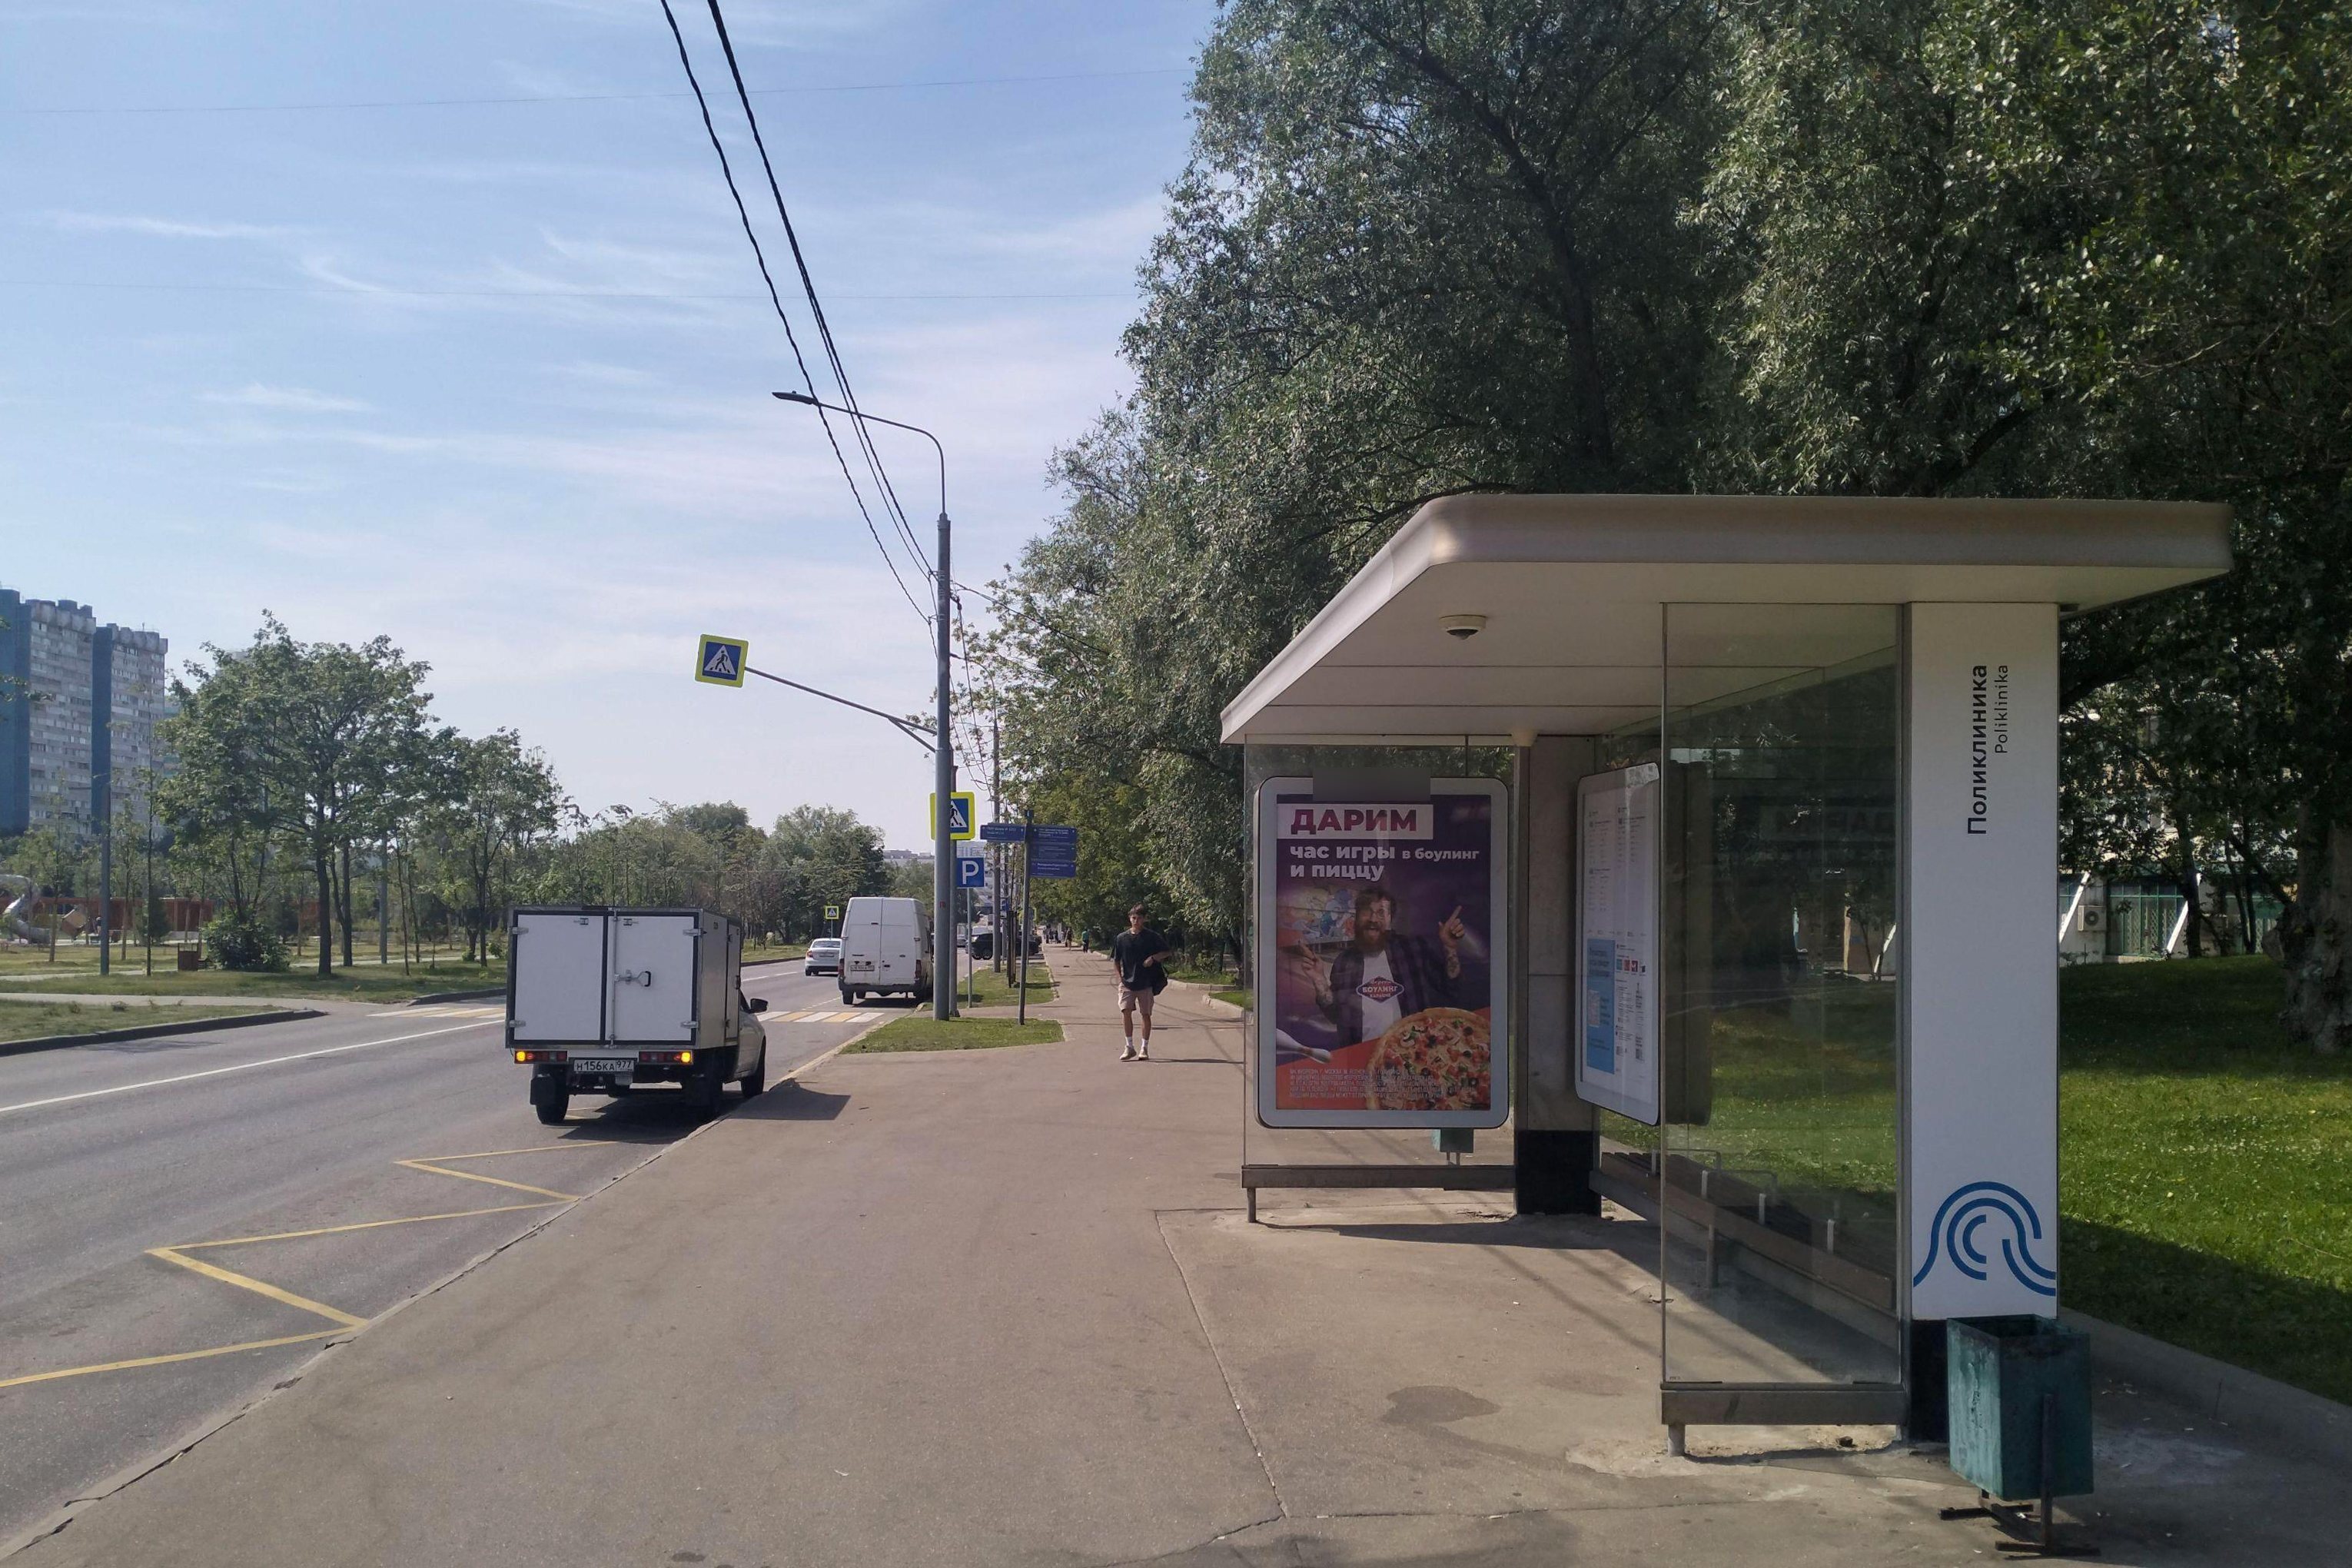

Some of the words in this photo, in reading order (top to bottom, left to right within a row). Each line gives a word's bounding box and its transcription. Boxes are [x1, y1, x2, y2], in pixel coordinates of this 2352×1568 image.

[1994, 665, 2008, 753] Poliklinika
[1967, 665, 1987, 835] Поликлиника
[1291, 809, 1417, 835] ДАРИМ
[1290, 845, 1330, 859] час
[1336, 845, 1395, 863] игры
[1402, 849, 1411, 859] в
[1415, 847, 1480, 862] боулинг
[1291, 864, 1305, 878] и
[1311, 864, 1384, 882] пиццу
